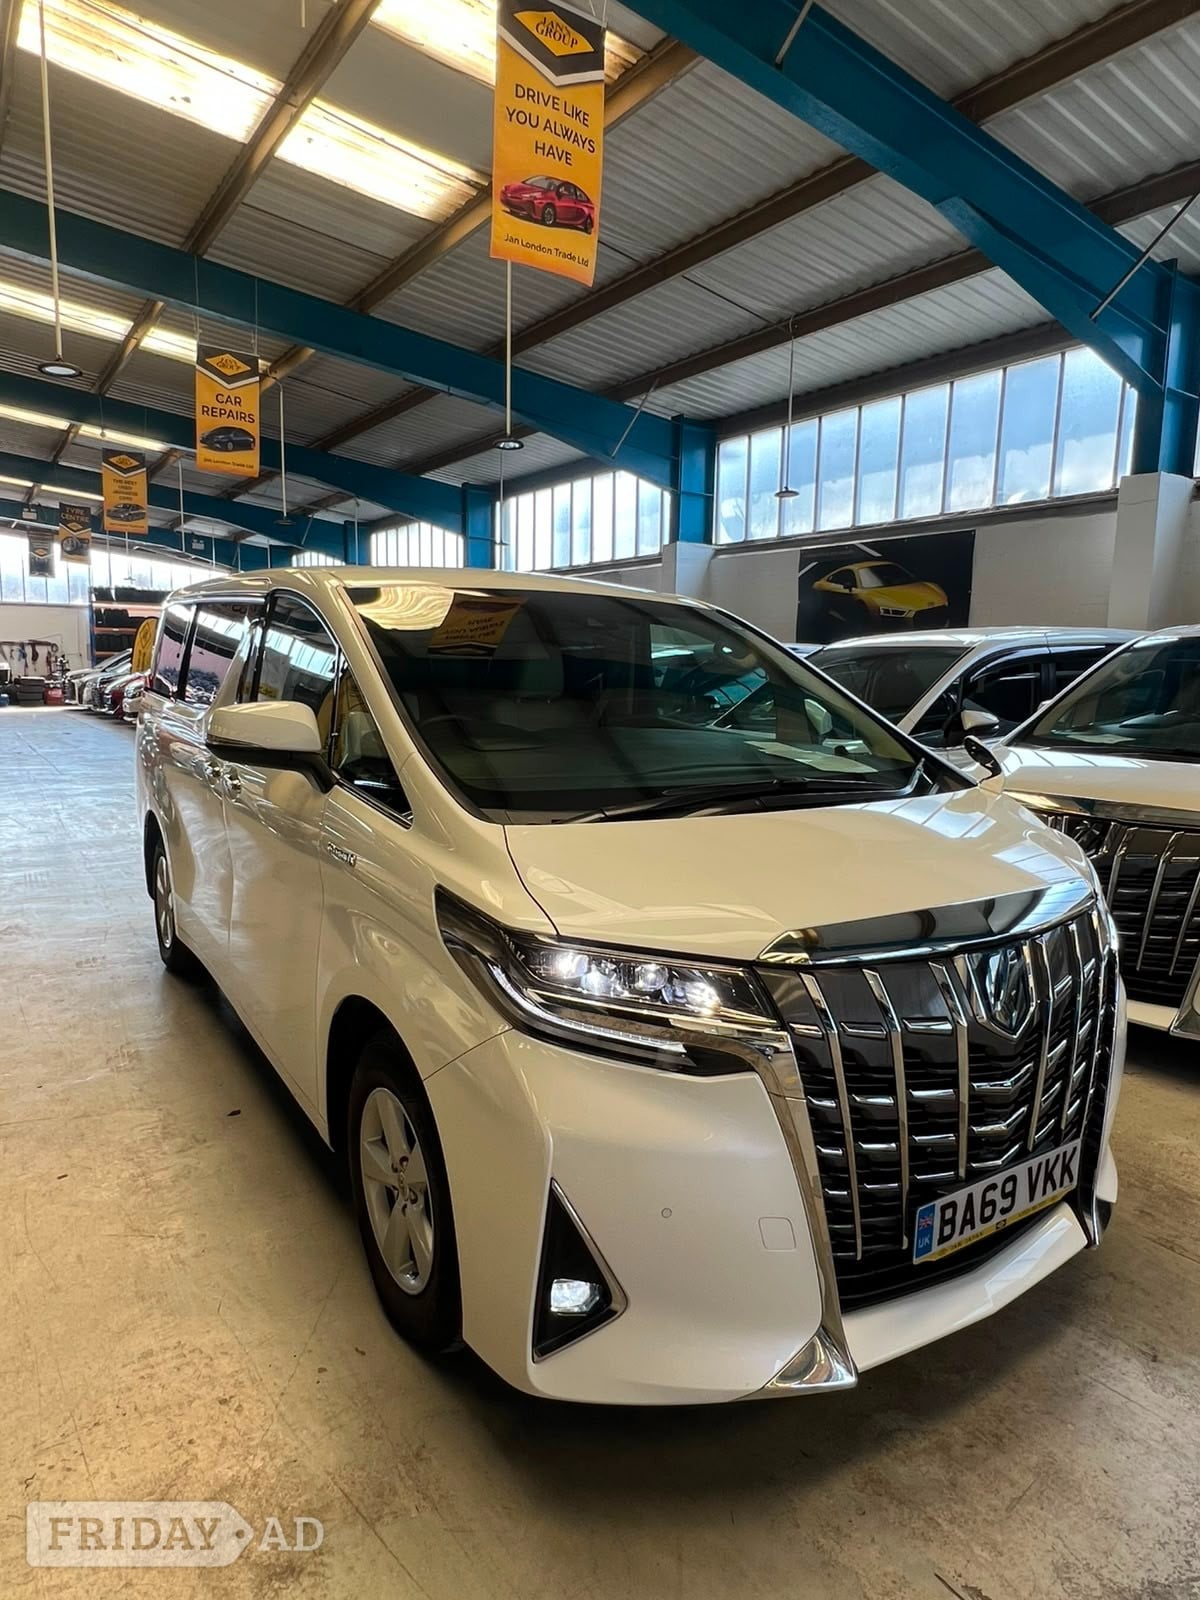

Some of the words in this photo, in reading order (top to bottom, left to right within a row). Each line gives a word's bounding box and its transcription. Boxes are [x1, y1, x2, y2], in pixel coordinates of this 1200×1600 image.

[535, 22, 578, 48] GROUP
[515, 83, 560, 111] DRIVE
[563, 100, 590, 128] LIKE
[506, 106, 540, 129] YOU
[542, 118, 596, 153] ALWAYS
[534, 140, 573, 166] HAVE
[504, 233, 520, 246] Jan
[521, 240, 553, 255] London
[554, 247, 577, 263] Trade
[577, 256, 589, 267] Ltd
[215, 393, 242, 407] CAR
[201, 405, 255, 424] REPAIRS
[937, 1174, 1018, 1247] BA69
[1027, 1146, 1078, 1203] VKK
[918, 1237, 930, 1248] UK
